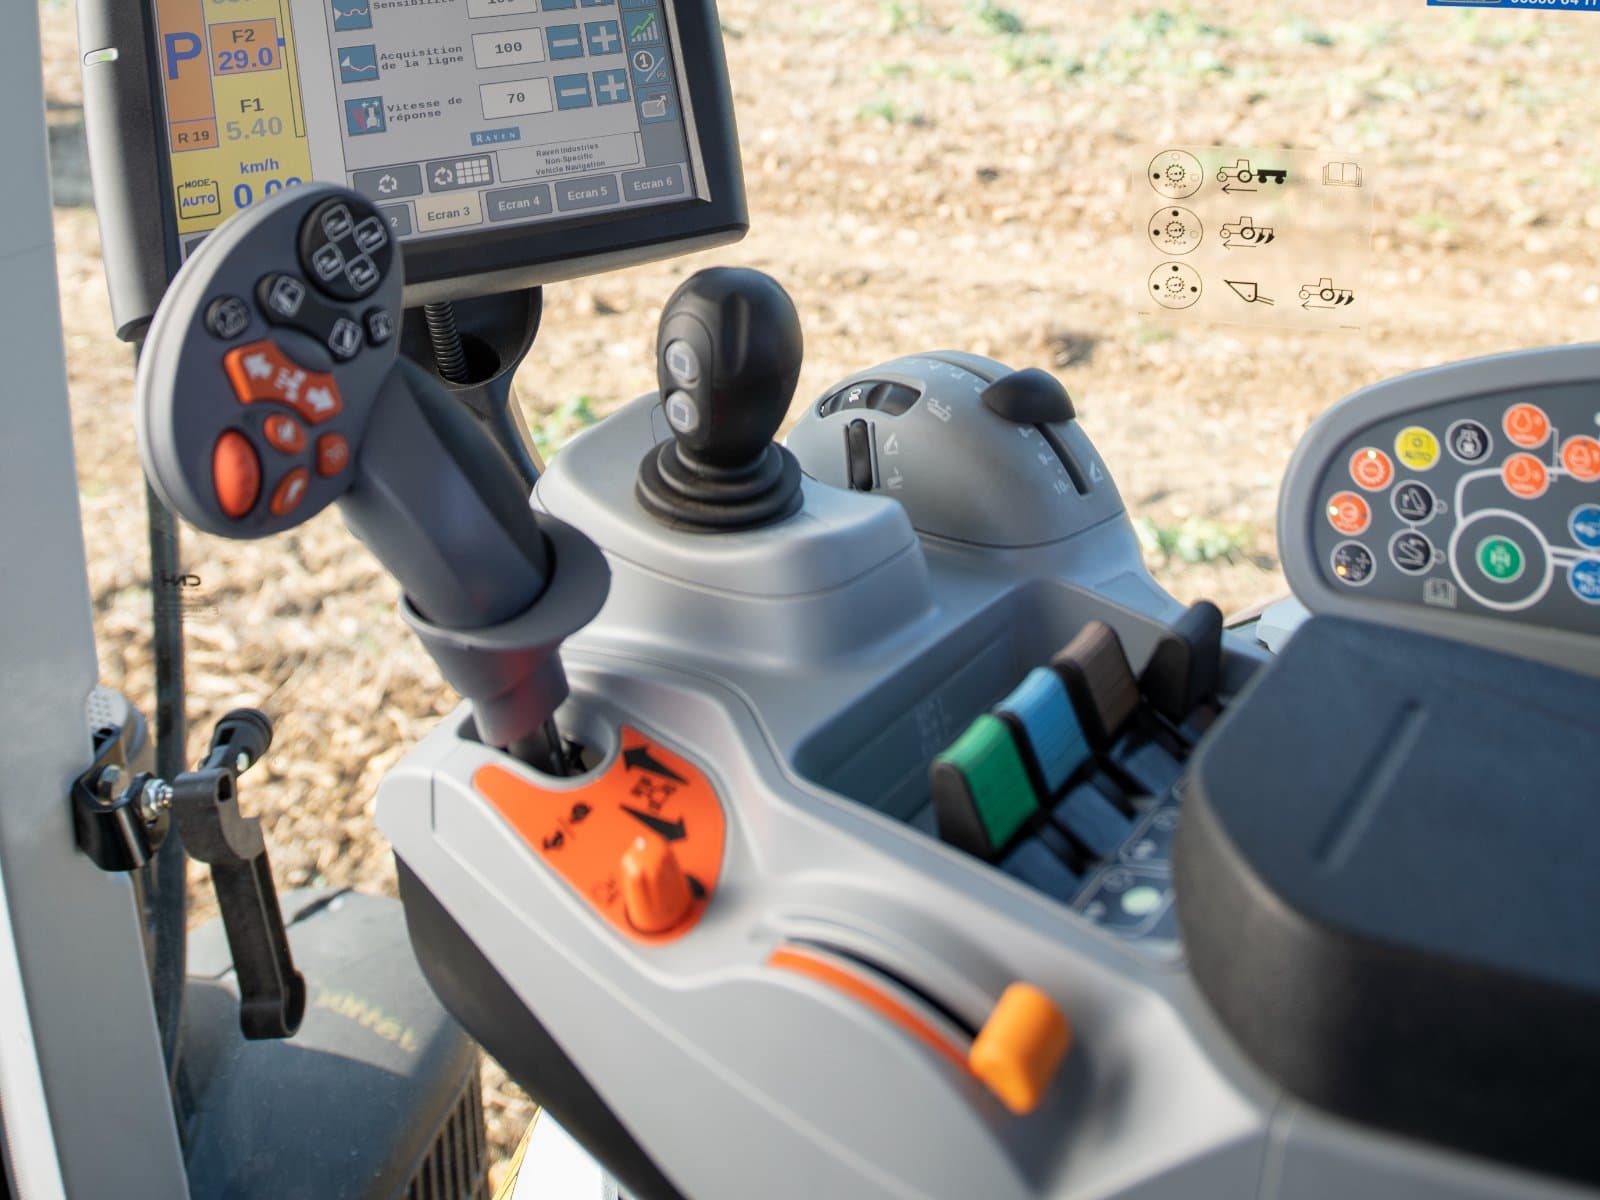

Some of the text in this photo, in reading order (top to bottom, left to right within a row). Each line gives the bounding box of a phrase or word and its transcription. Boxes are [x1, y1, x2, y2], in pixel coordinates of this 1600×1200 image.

[232, 29, 255, 43] F2
[494, 42, 523, 54] 100
[164, 31, 202, 80] P
[218, 47, 273, 71] 29.0
[381, 55, 464, 70] de la ligne
[386, 96, 463, 112] Vitesse de
[506, 92, 526, 103] 70
[240, 98, 264, 112] F1
[388, 108, 442, 123] réponse
[226, 117, 282, 141] 5.40
[178, 130, 210, 144] R 19
[475, 130, 517, 144] RAVEN
[240, 158, 280, 174] km/h
[185, 179, 210, 188] MODE
[634, 177, 673, 191] Ecran 6
[182, 195, 216, 207] AUTO
[567, 187, 608, 201] Ecran 5
[498, 196, 540, 211] Ecran 4
[427, 207, 470, 221] Ecran 3
